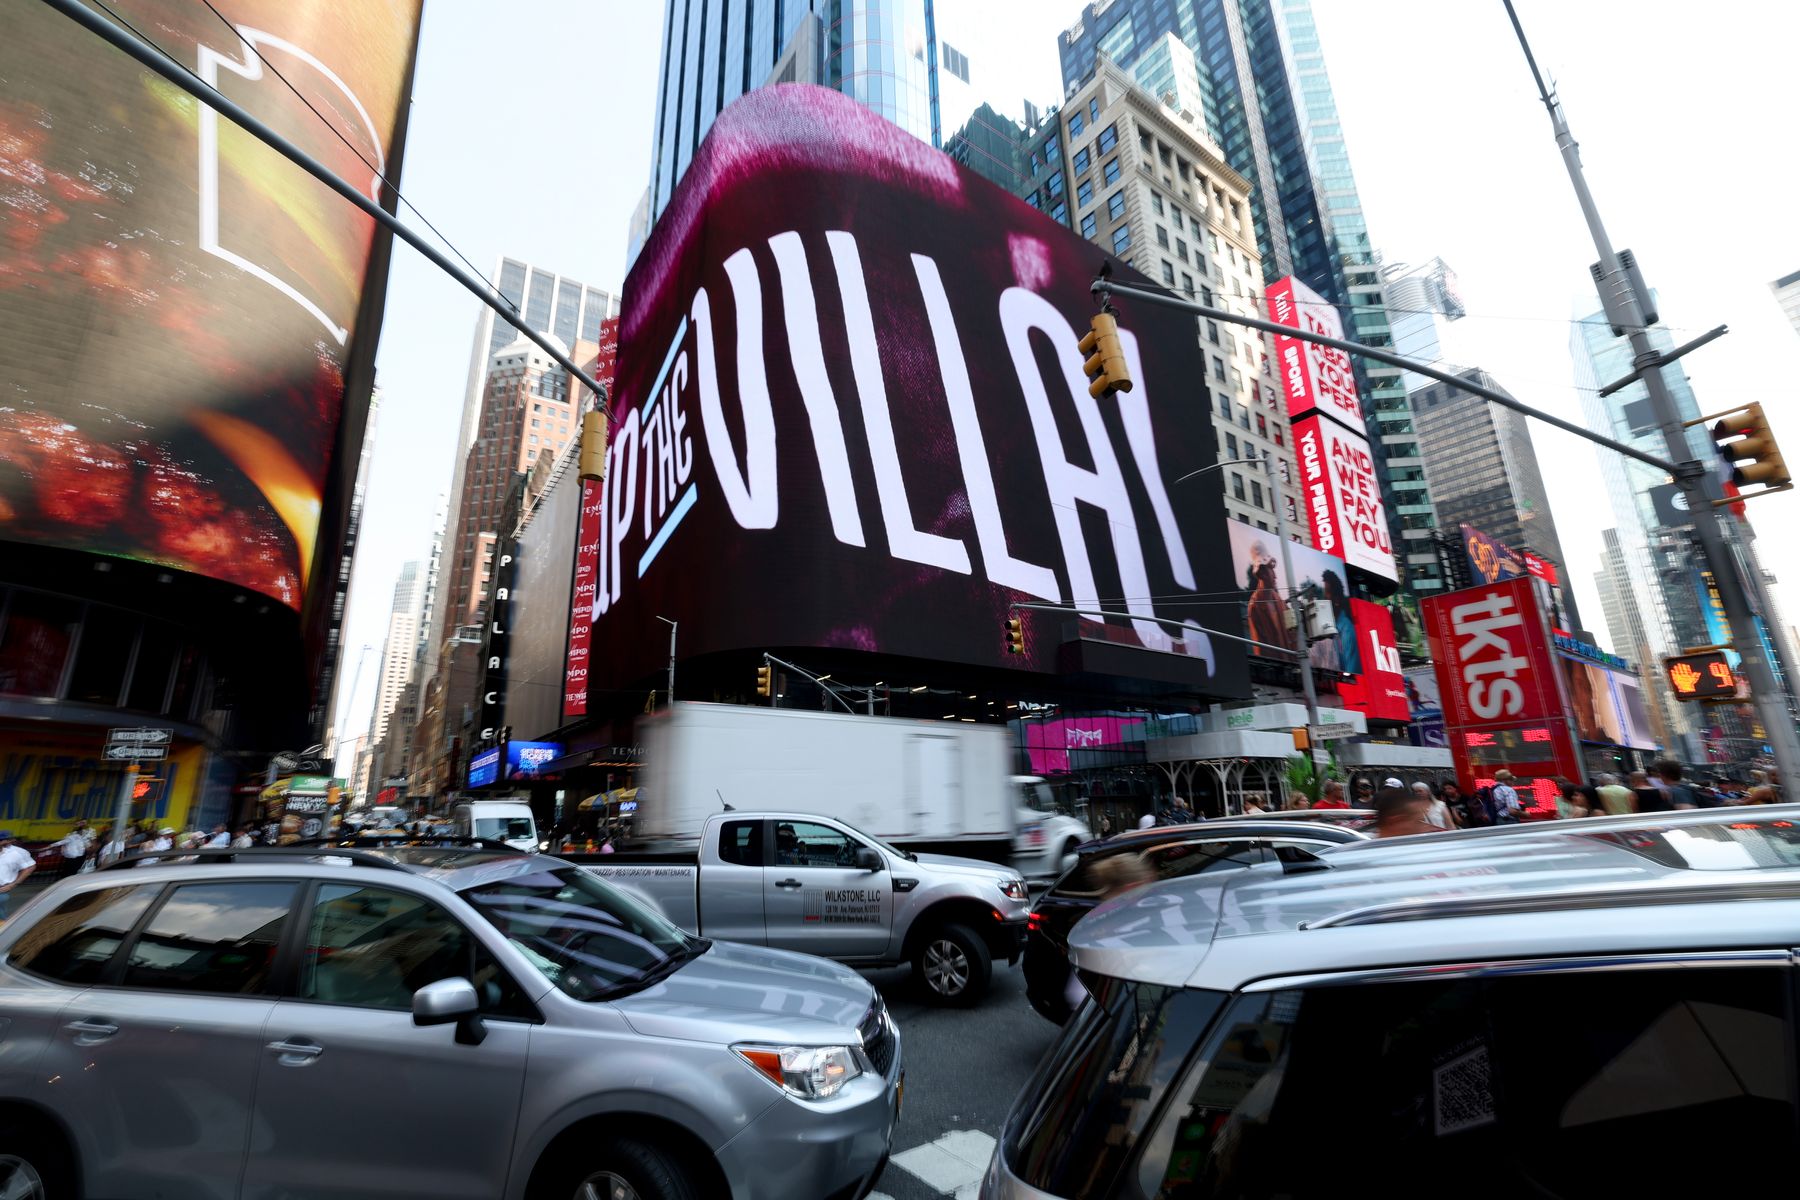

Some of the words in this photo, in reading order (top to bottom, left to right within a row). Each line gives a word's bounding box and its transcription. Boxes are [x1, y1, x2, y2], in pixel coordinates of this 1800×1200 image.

[1284, 345, 1306, 398] SPORT
[642, 349, 692, 540] THE
[1300, 430, 1321, 481] YOUR
[1332, 437, 1374, 476] AND
[1341, 487, 1377, 524] PAY
[480, 554, 512, 740] PALACE
[1451, 593, 1528, 719] tkts
[1709, 662, 1734, 688] 9
[825, 890, 867, 903] WILKSTONE,
[867, 890, 881, 902] LLC
